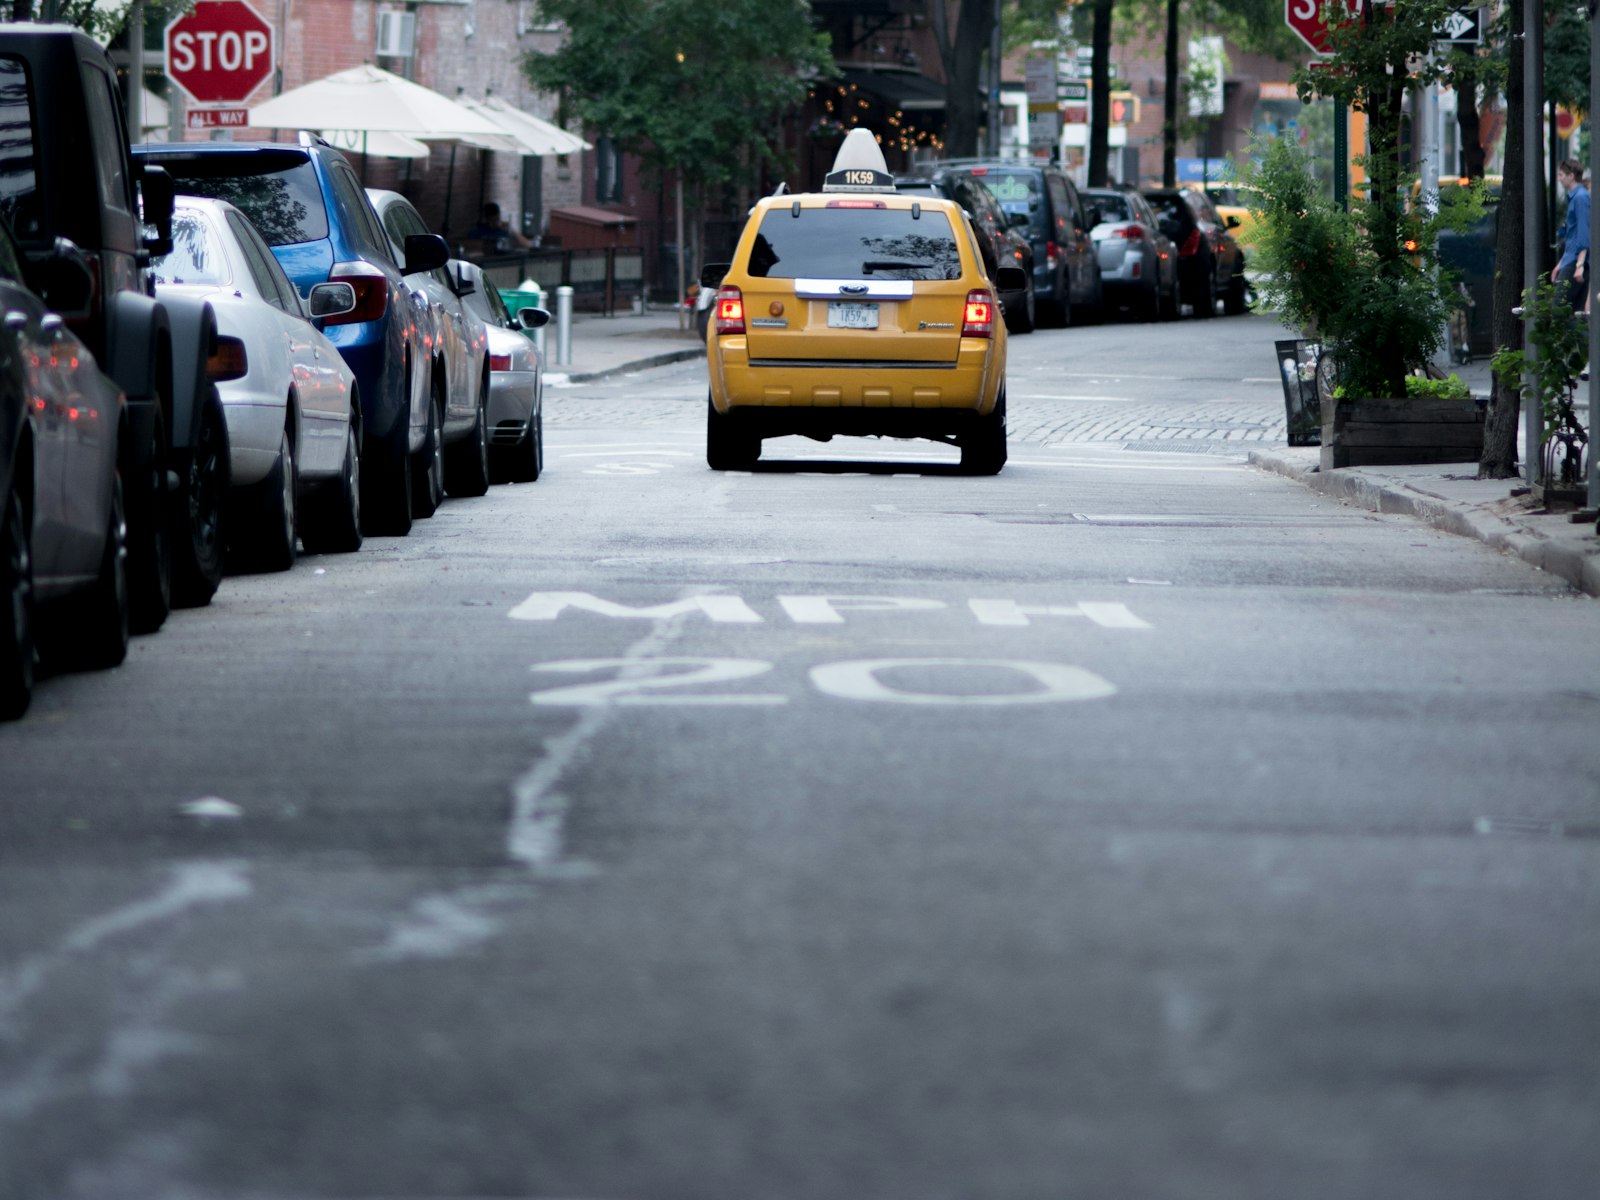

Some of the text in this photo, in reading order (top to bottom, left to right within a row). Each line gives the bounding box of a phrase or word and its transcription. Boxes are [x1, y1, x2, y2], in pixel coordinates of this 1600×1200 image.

[173, 31, 268, 72] STOP
[190, 111, 246, 126] ALL WAY
[845, 171, 874, 185] 1K59
[840, 309, 862, 322] 1K59
[506, 589, 1155, 630] MPH
[528, 657, 1119, 705] 20
